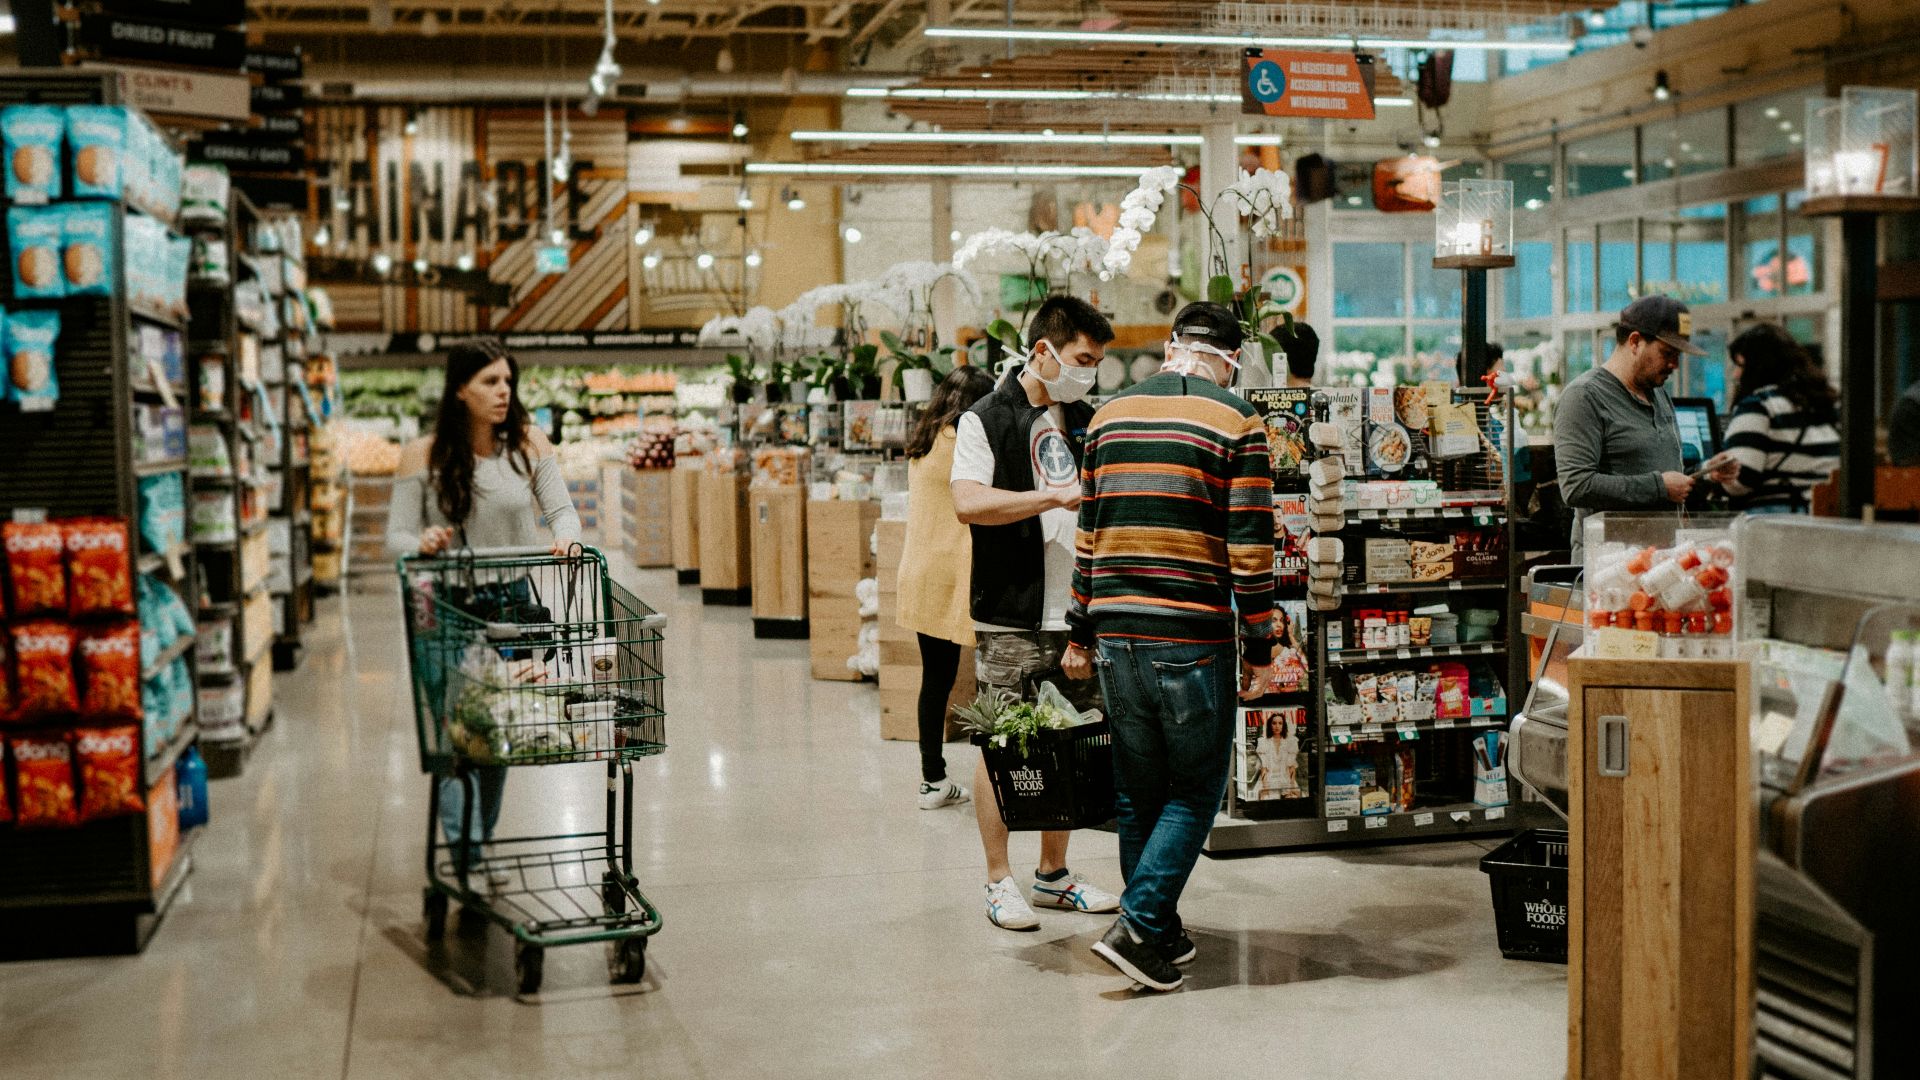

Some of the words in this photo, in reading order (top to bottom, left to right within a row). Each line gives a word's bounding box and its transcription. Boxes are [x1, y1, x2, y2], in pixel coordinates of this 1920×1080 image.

[111, 22, 166, 43] DRIED
[168, 29, 216, 48] FRUIT
[204, 145, 251, 160] CEREAL
[1871, 143, 1889, 193] 7
[1251, 392, 1307, 402] PLANT-BASED
[1267, 401, 1292, 410] FOOD
[1371, 414, 1393, 422] OVEN
[1425, 546, 1446, 559] dang
[1425, 564, 1446, 577] dang
[1247, 710, 1281, 727] VANI
[1009, 769, 1043, 781] WHOLE
[1013, 780, 1044, 792] FOODS
[1524, 901, 1567, 915] WHOLE
[1526, 912, 1566, 925] FOODS
